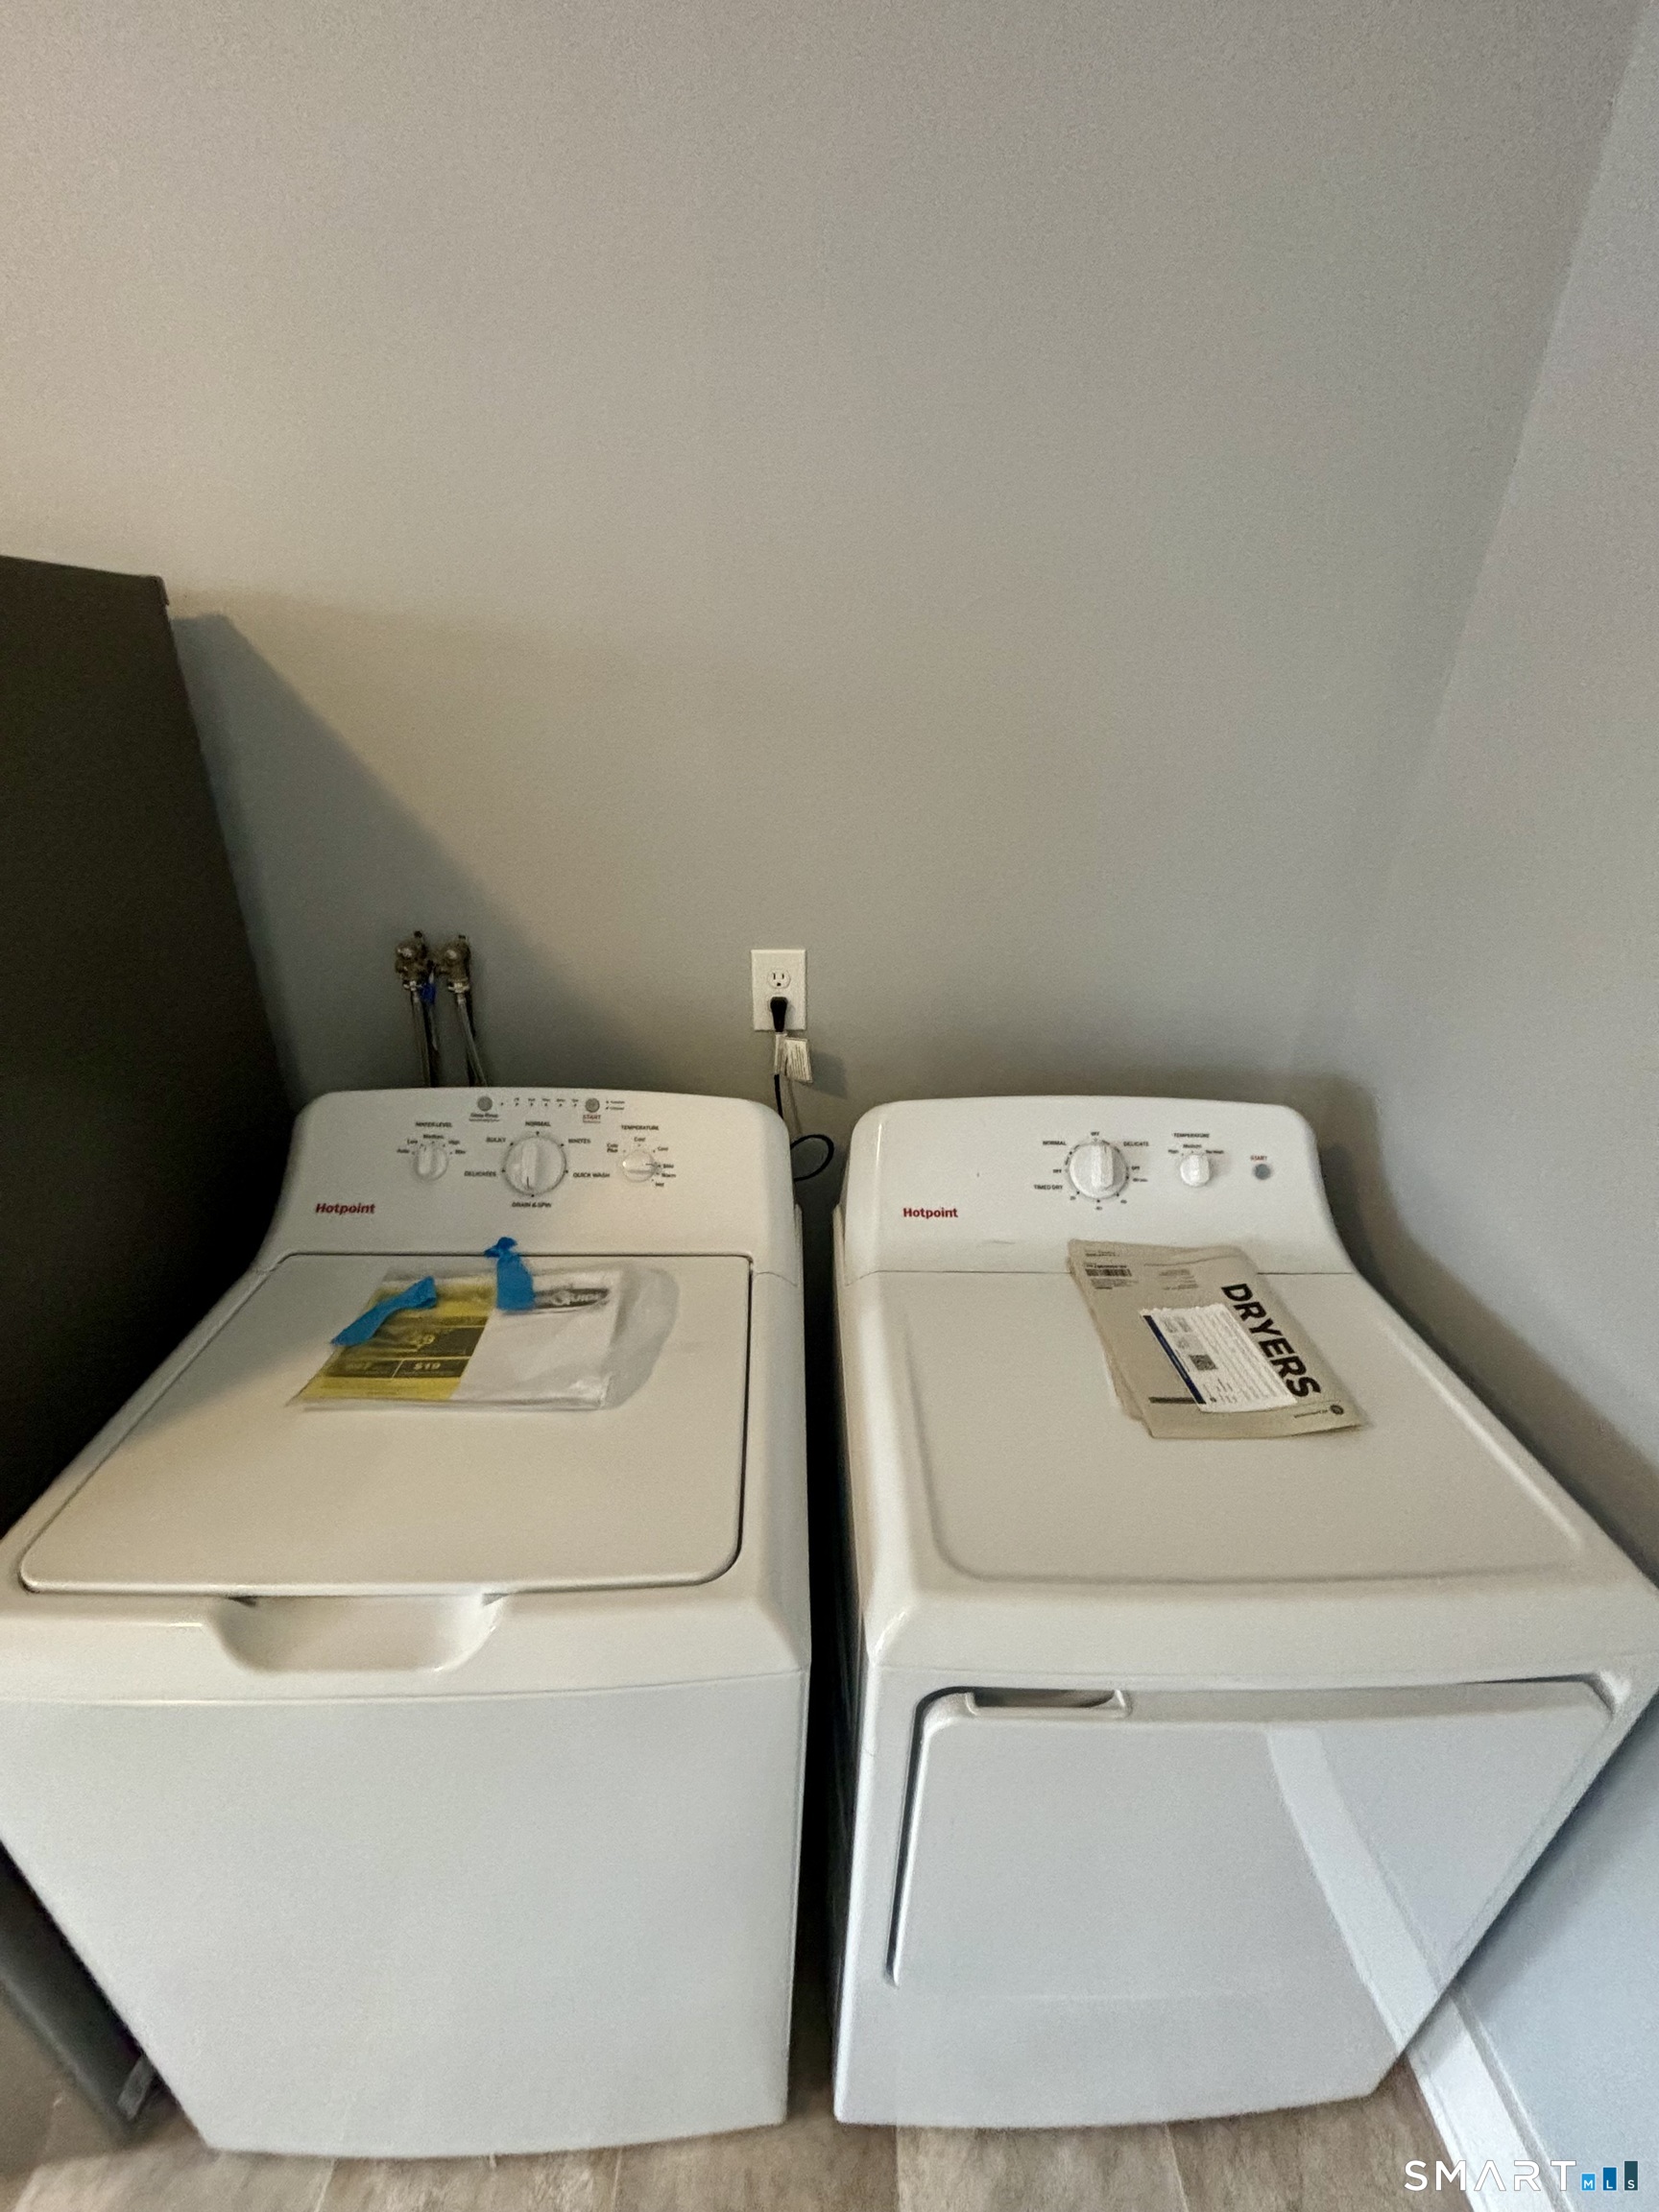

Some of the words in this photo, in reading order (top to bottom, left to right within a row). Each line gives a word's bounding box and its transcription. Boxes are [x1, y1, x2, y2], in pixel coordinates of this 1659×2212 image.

[315, 1203, 375, 1214] Hotpoint
[903, 1207, 958, 1219] Hotpoint
[1221, 1283, 1321, 1398] DRYERS
